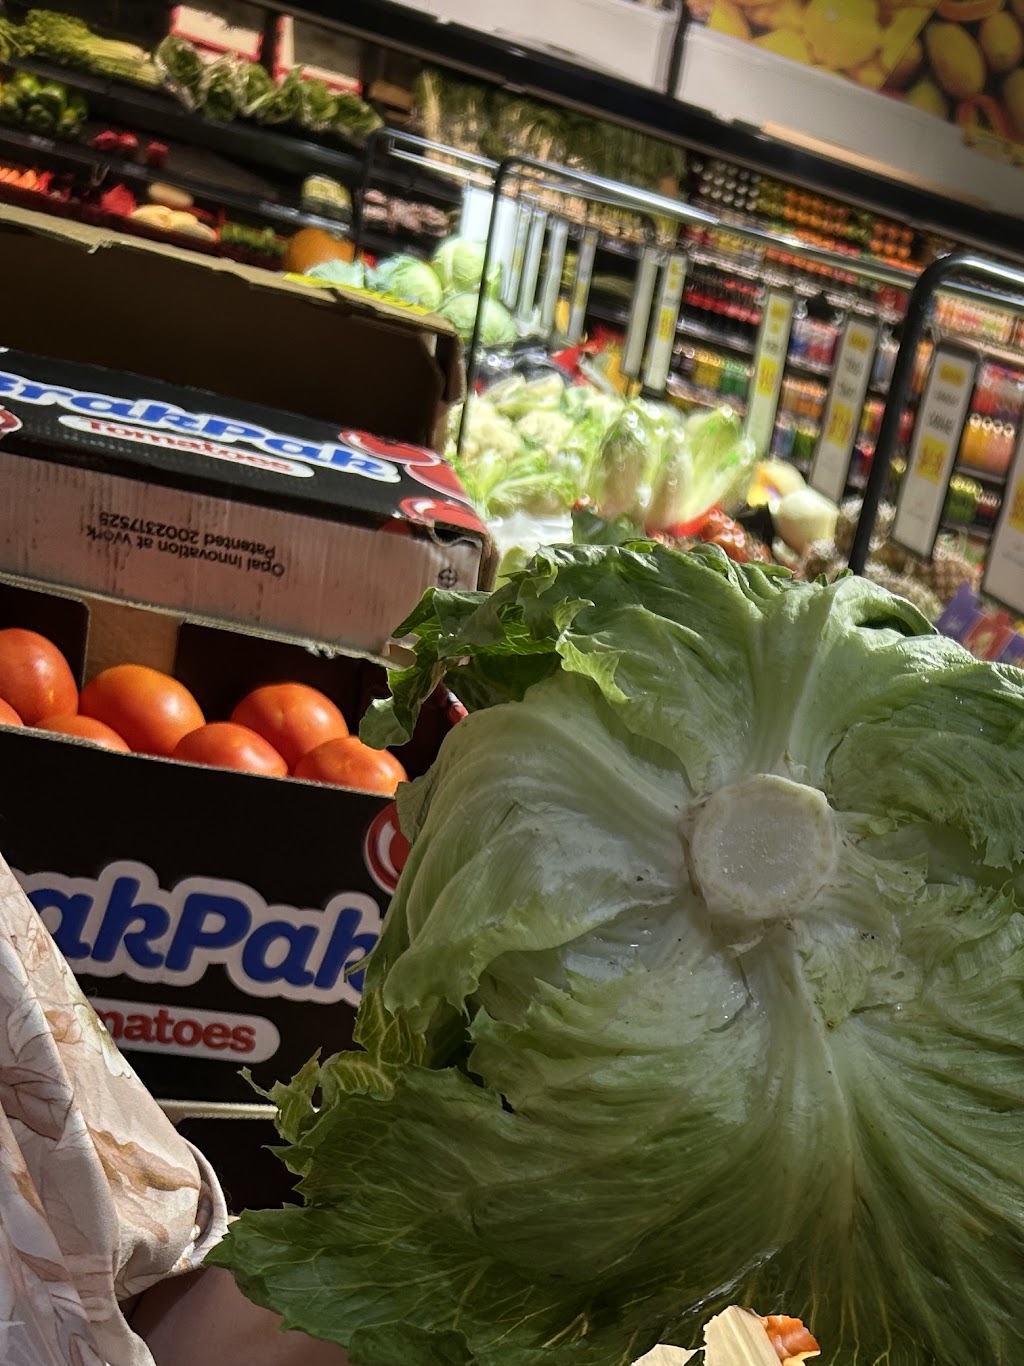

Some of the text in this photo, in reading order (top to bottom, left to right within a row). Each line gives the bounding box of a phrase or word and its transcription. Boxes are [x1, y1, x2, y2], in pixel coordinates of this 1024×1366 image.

[88, 419, 294, 474] Tomatoes
[136, 535, 153, 551] at
[158, 541, 242, 570] Innovation
[204, 534, 276, 560] Patented
[247, 557, 285, 578] Opal
